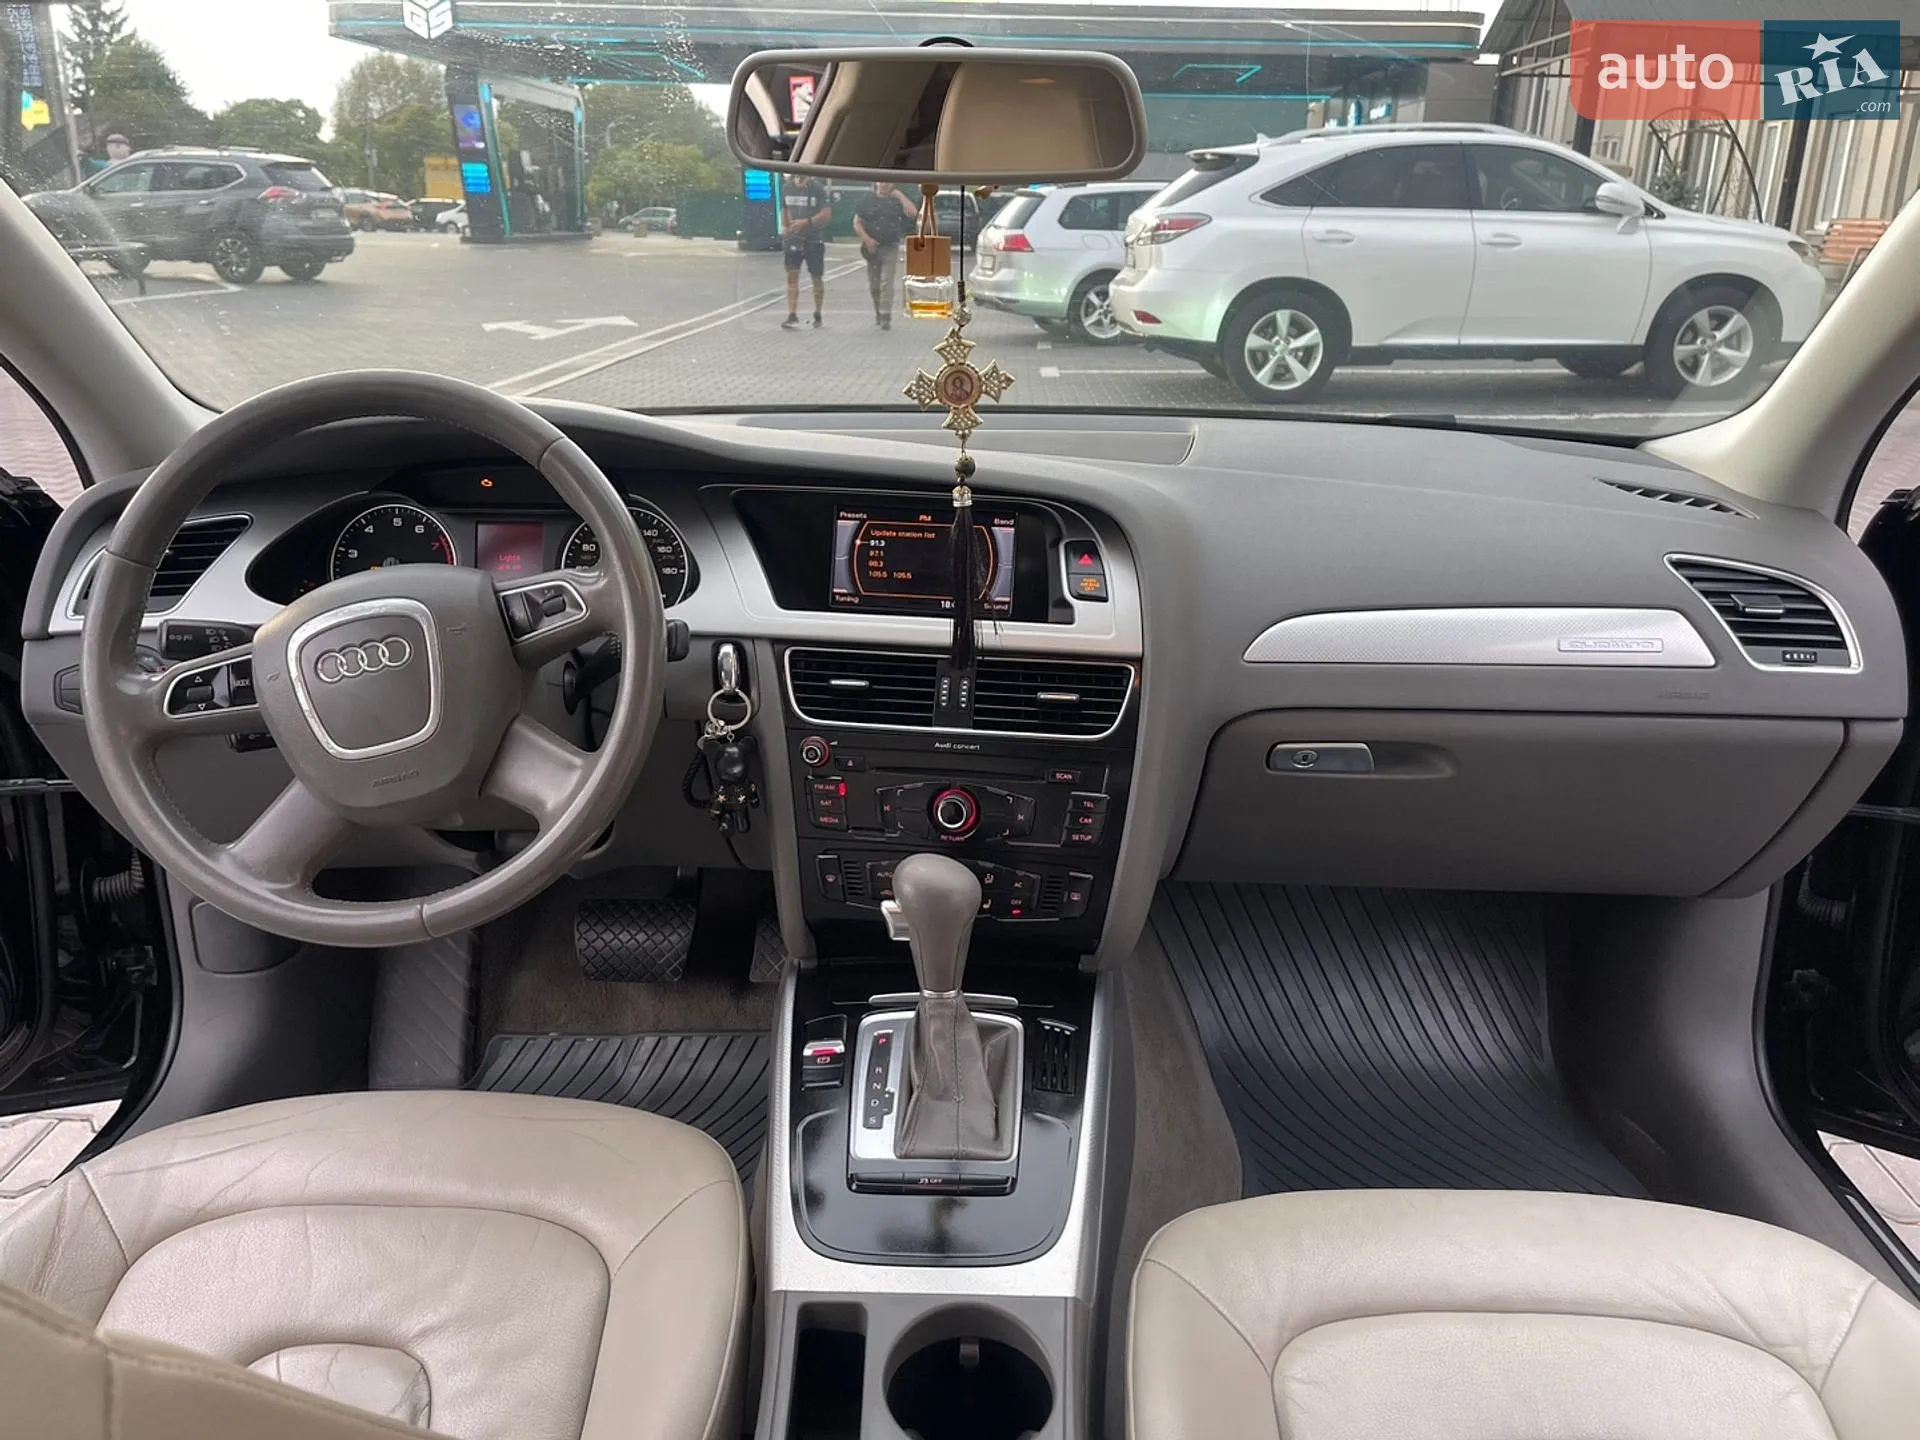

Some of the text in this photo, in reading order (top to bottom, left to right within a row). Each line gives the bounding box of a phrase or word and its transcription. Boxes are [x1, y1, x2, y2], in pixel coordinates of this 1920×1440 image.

[839, 511, 867, 519] Presets
[392, 517, 403, 527] 5
[364, 525, 374, 534] 4
[414, 525, 425, 534] 6
[642, 529, 659, 537] 140
[870, 529, 897, 538] Update
[431, 542, 440, 551] 7
[582, 543, 596, 552] 80
[347, 549, 358, 559] 3
[835, 595, 859, 604] Tuning
[872, 1082, 881, 1090] N
[871, 1099, 879, 1107] D
[869, 1116, 876, 1124] S
